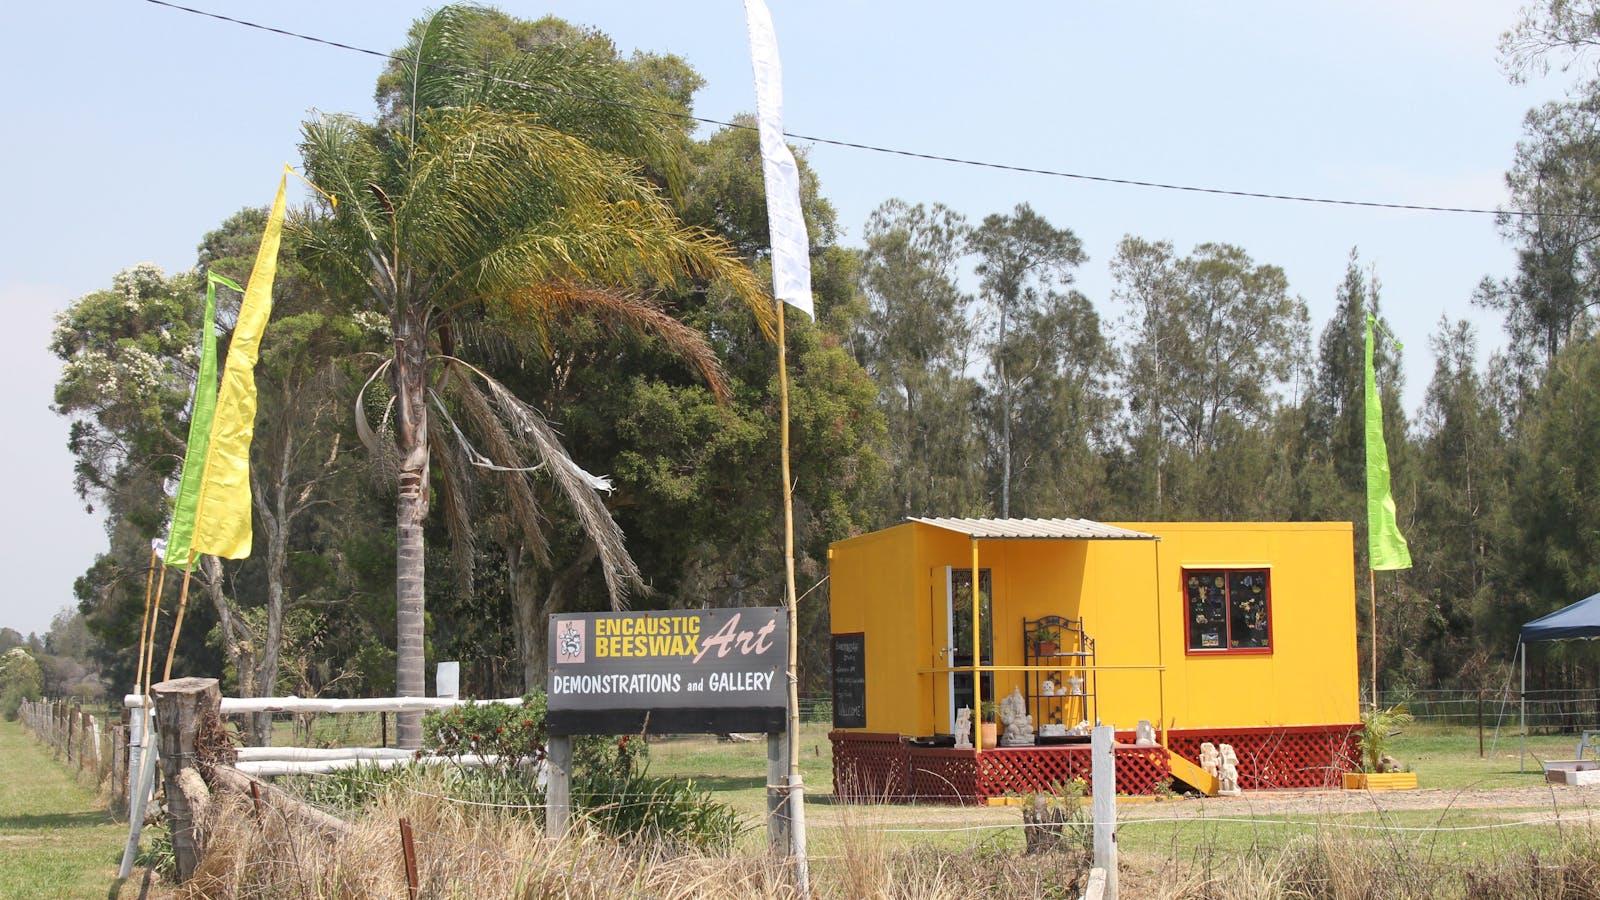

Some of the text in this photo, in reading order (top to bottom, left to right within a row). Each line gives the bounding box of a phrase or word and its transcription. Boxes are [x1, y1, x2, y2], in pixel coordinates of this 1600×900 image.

[595, 616, 701, 636] ENCAUSTIC
[595, 635, 699, 658] BEESWAX
[692, 612, 776, 664] Art
[553, 671, 775, 694] DEMONSTRATIONS and GALLERY
